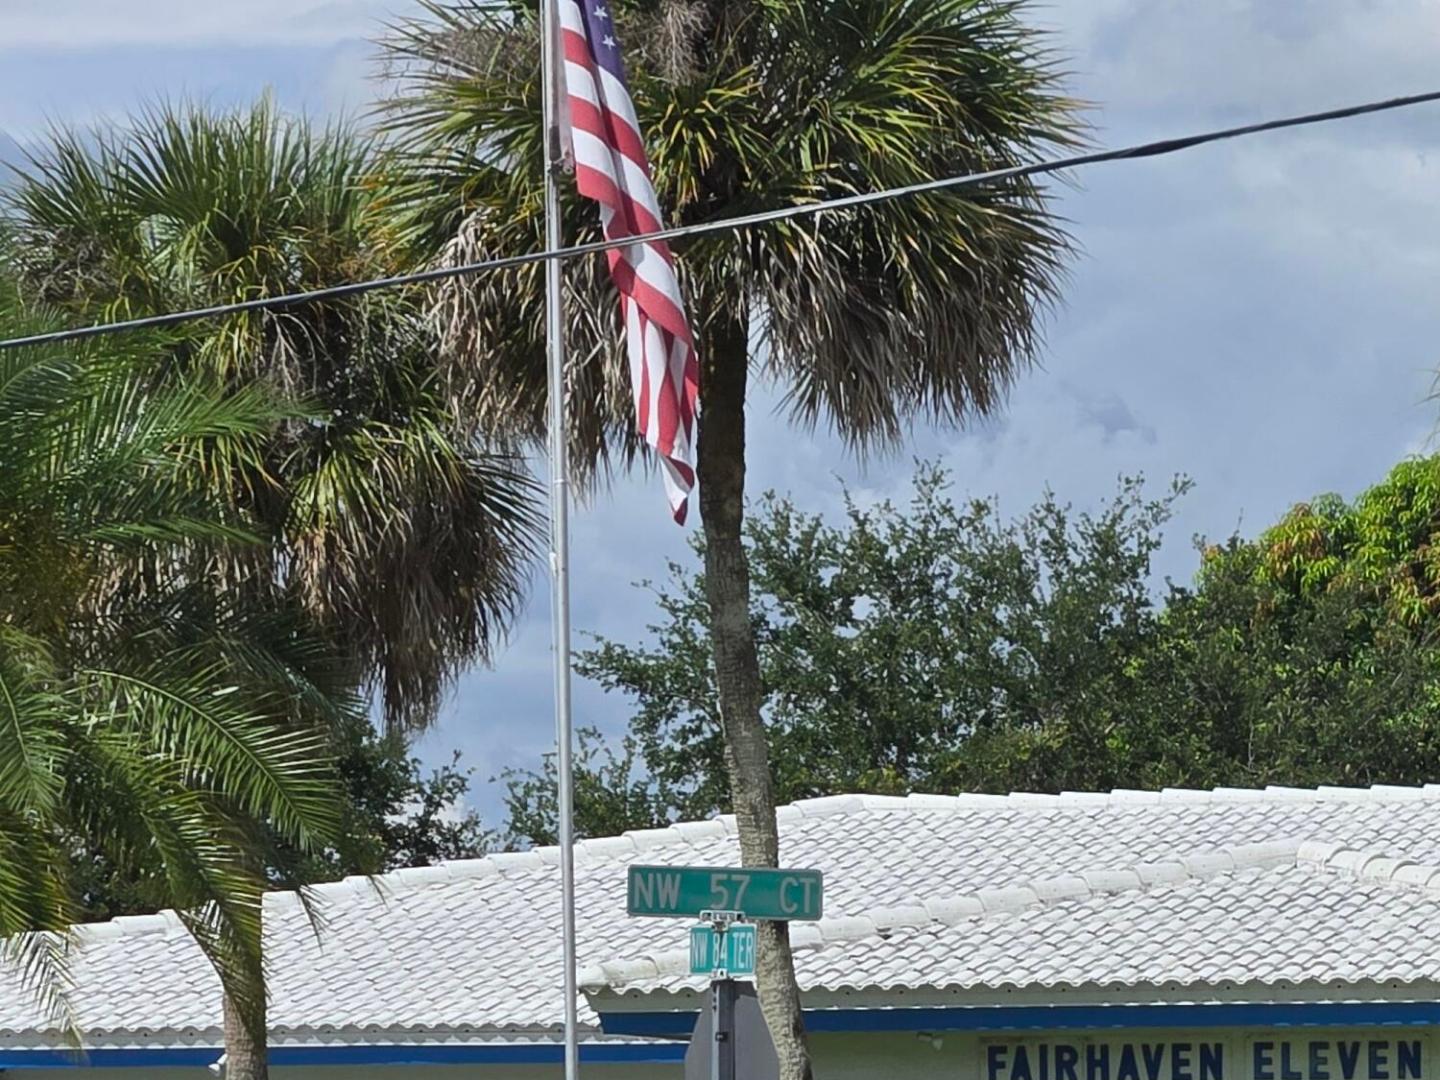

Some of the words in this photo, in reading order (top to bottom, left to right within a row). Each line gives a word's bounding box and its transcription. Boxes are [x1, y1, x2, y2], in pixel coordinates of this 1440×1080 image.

[633, 872, 681, 911] NW
[710, 873, 751, 911] 57
[779, 877, 817, 914] CT
[691, 932, 708, 969] NW
[712, 932, 728, 969] 84
[732, 931, 754, 969] TER
[1252, 1040, 1422, 1080] ELEVEN
